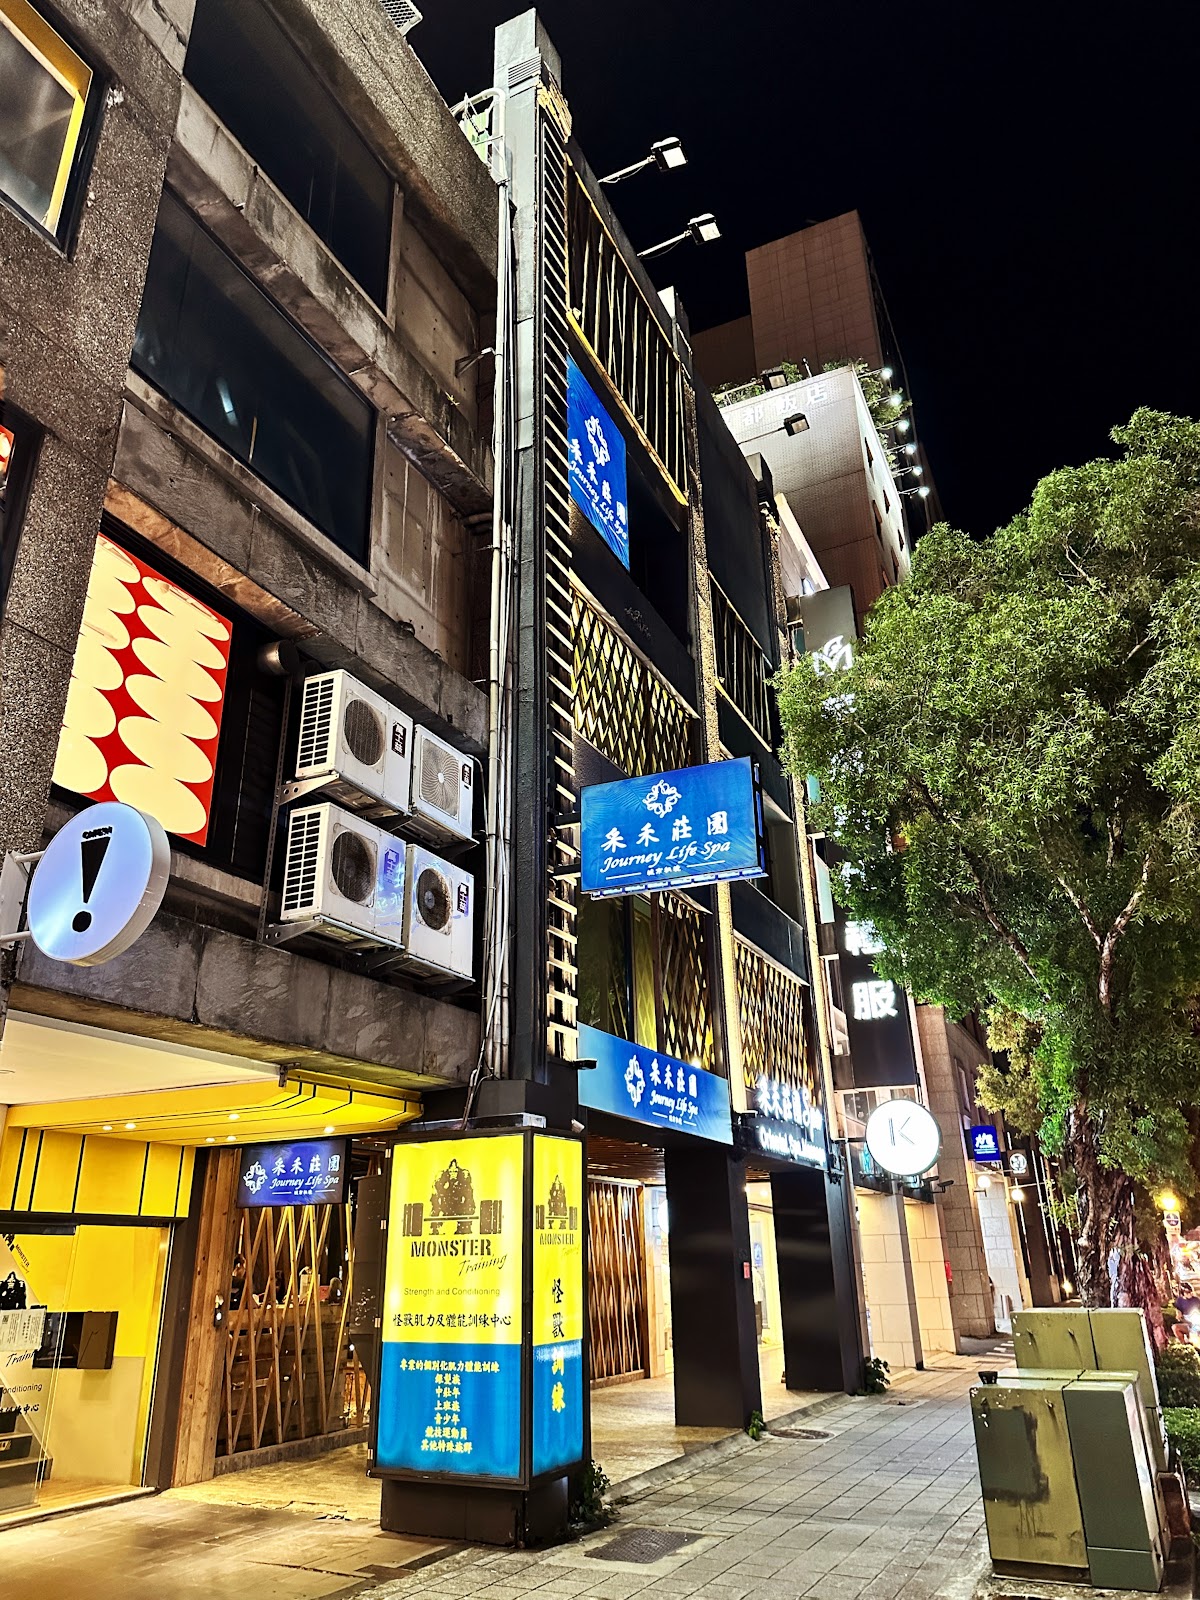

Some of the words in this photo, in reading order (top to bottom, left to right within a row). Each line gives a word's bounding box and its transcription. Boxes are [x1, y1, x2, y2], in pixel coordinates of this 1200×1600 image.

[569, 460, 600, 504] Journey
[600, 501, 615, 523] Life
[613, 517, 628, 541] Spa
[600, 851, 663, 873] Journey
[665, 840, 698, 864] Life
[700, 840, 731, 861] Spa
[649, 1089, 676, 1114] Journey
[675, 1096, 688, 1117] Life
[687, 1101, 699, 1120] Spa
[887, 1115, 916, 1147] K
[269, 1178, 304, 1190] Journey
[305, 1173, 322, 1189] Life
[322, 1175, 340, 1188] Spa
[411, 1239, 492, 1258] MONSTER
[539, 1233, 574, 1246] MONSTER
[458, 1254, 508, 1277] Training
[403, 1287, 434, 1298] Strength
[436, 1287, 450, 1296] and
[451, 1287, 500, 1297] Conditioning
